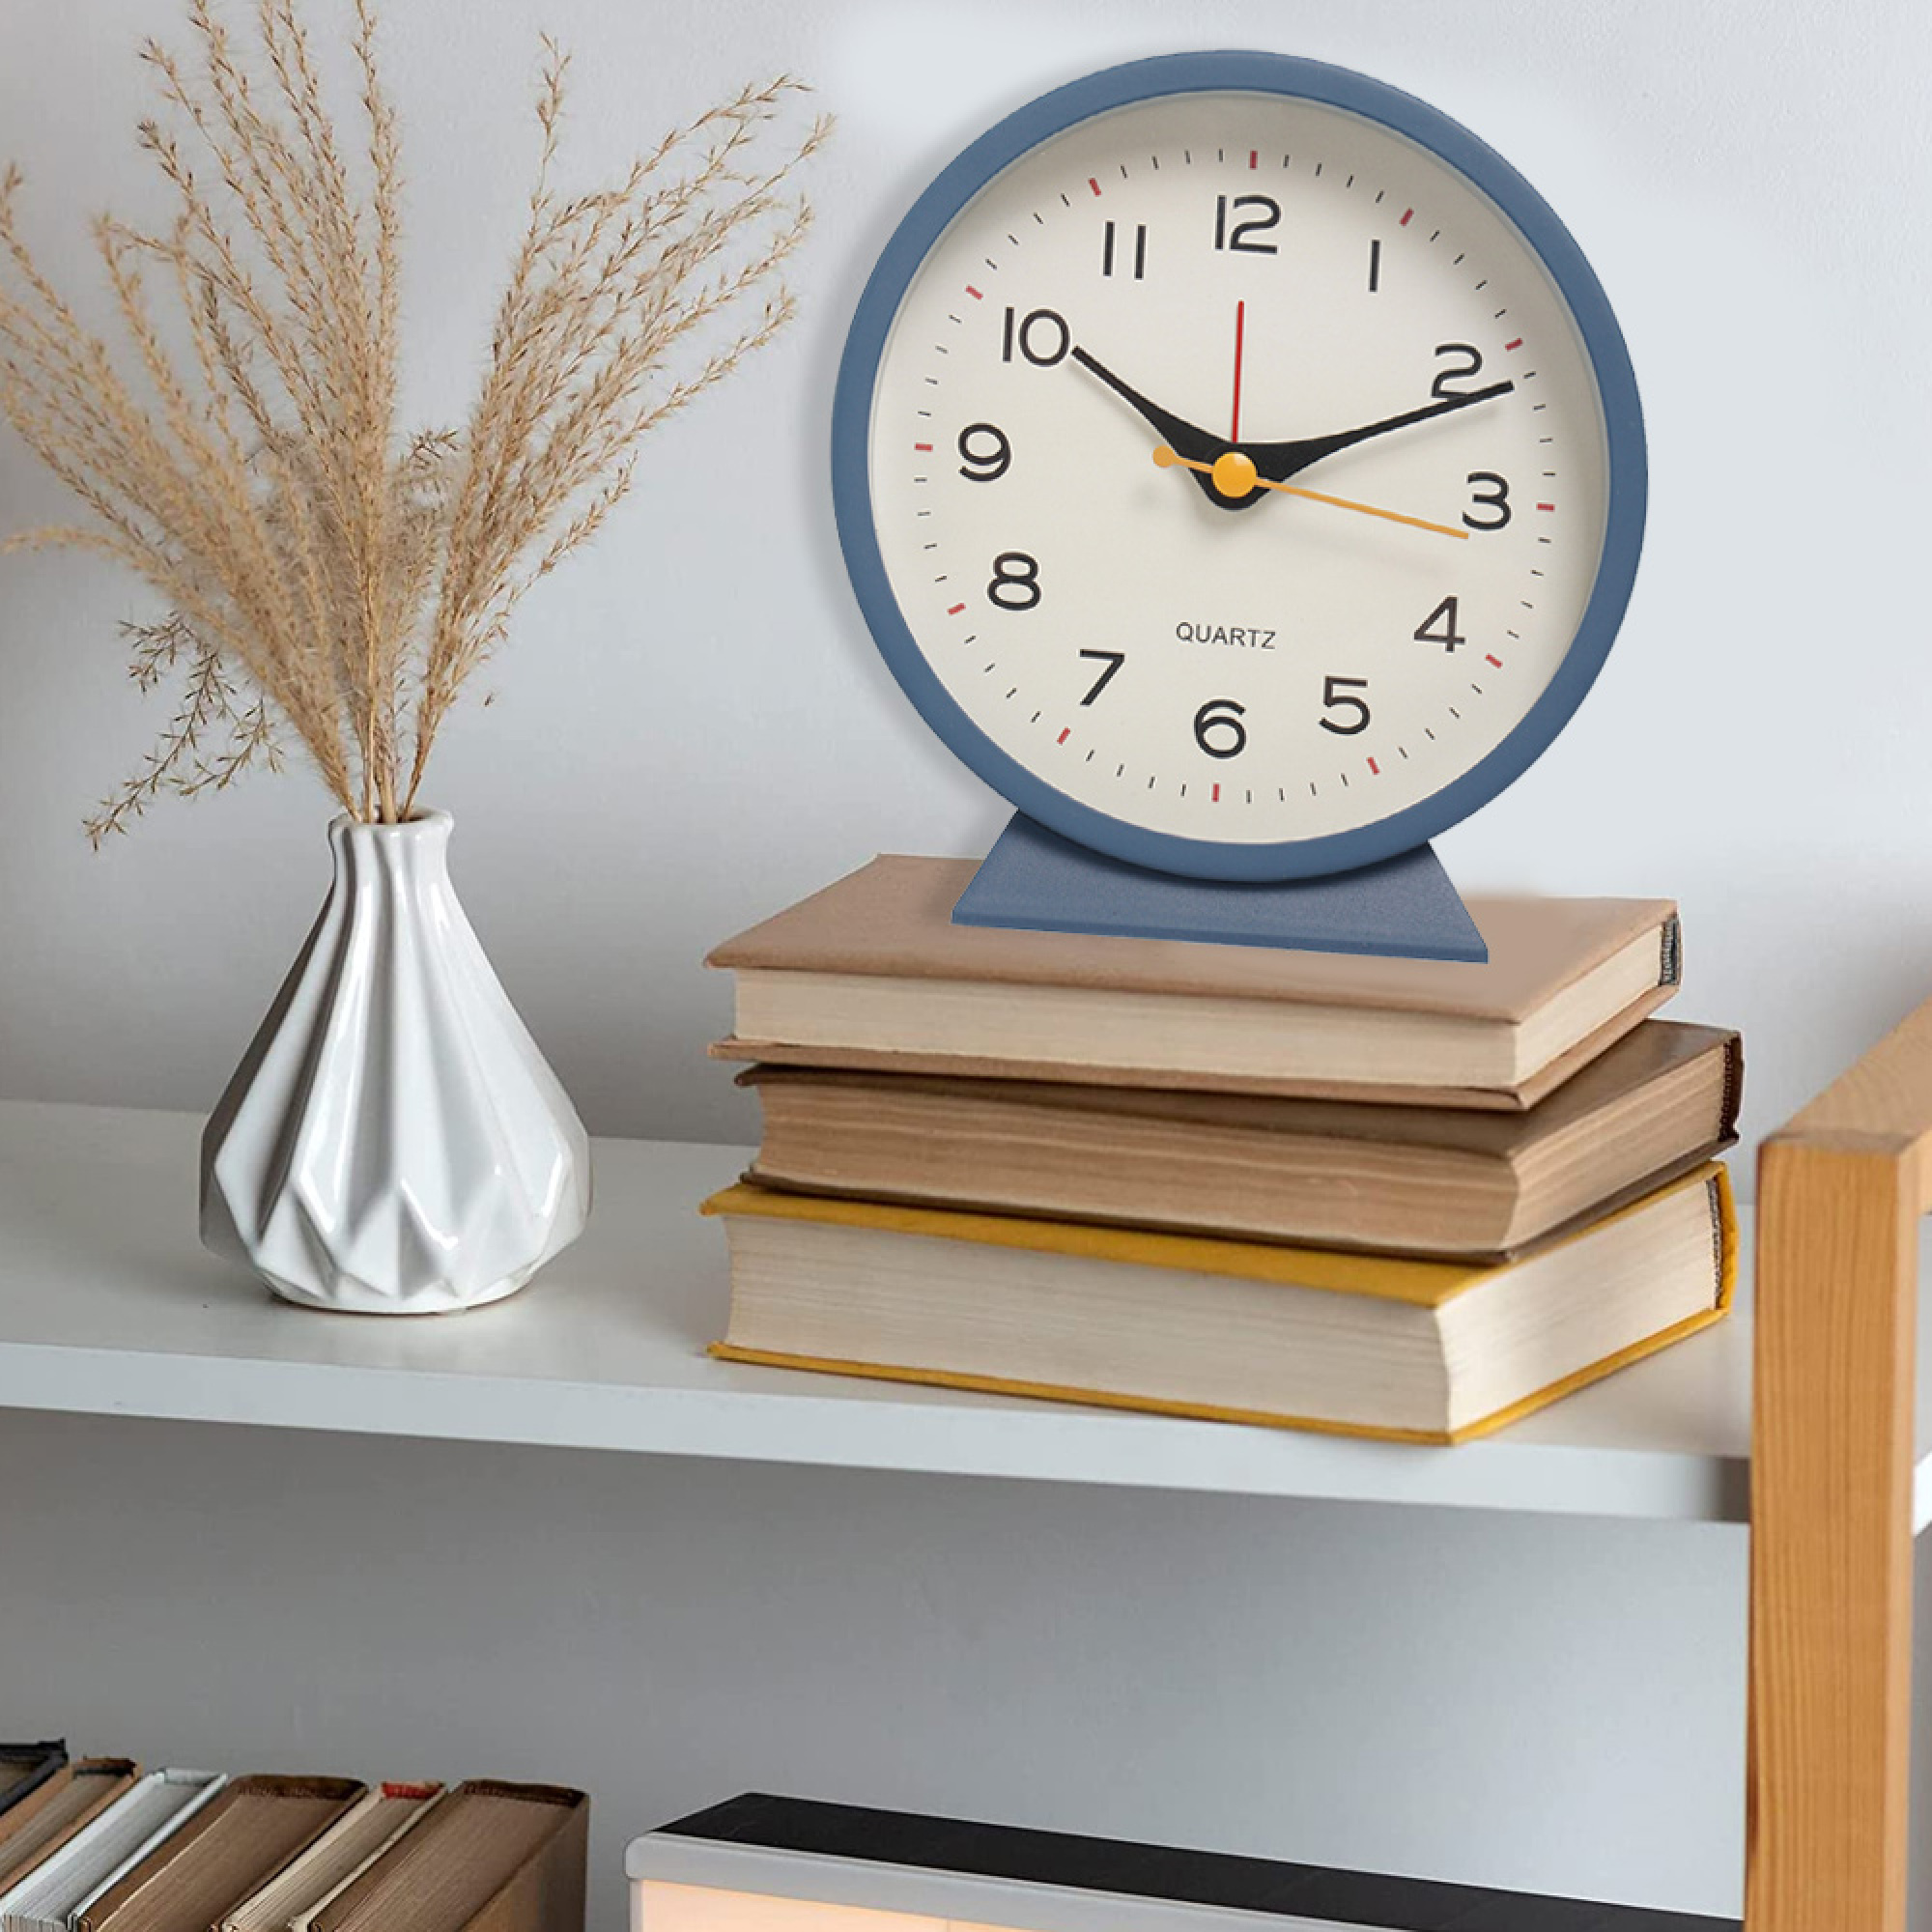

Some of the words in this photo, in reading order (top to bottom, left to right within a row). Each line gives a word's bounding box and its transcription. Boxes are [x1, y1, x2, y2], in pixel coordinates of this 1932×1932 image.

[1102, 220, 1148, 280] 11
[1214, 193, 1283, 255] 12
[1368, 239, 1381, 294] 1
[1002, 305, 1071, 367] 10
[1431, 343, 1483, 401] 2
[957, 422, 1012, 483] 9
[1462, 470, 1513, 531] 3
[986, 551, 1042, 612] 8
[1175, 621, 1276, 649] QUARTZ
[1413, 595, 1466, 653] 4
[1078, 647, 1126, 707] 7
[1319, 674, 1371, 736] 5
[1193, 697, 1248, 760] 6
